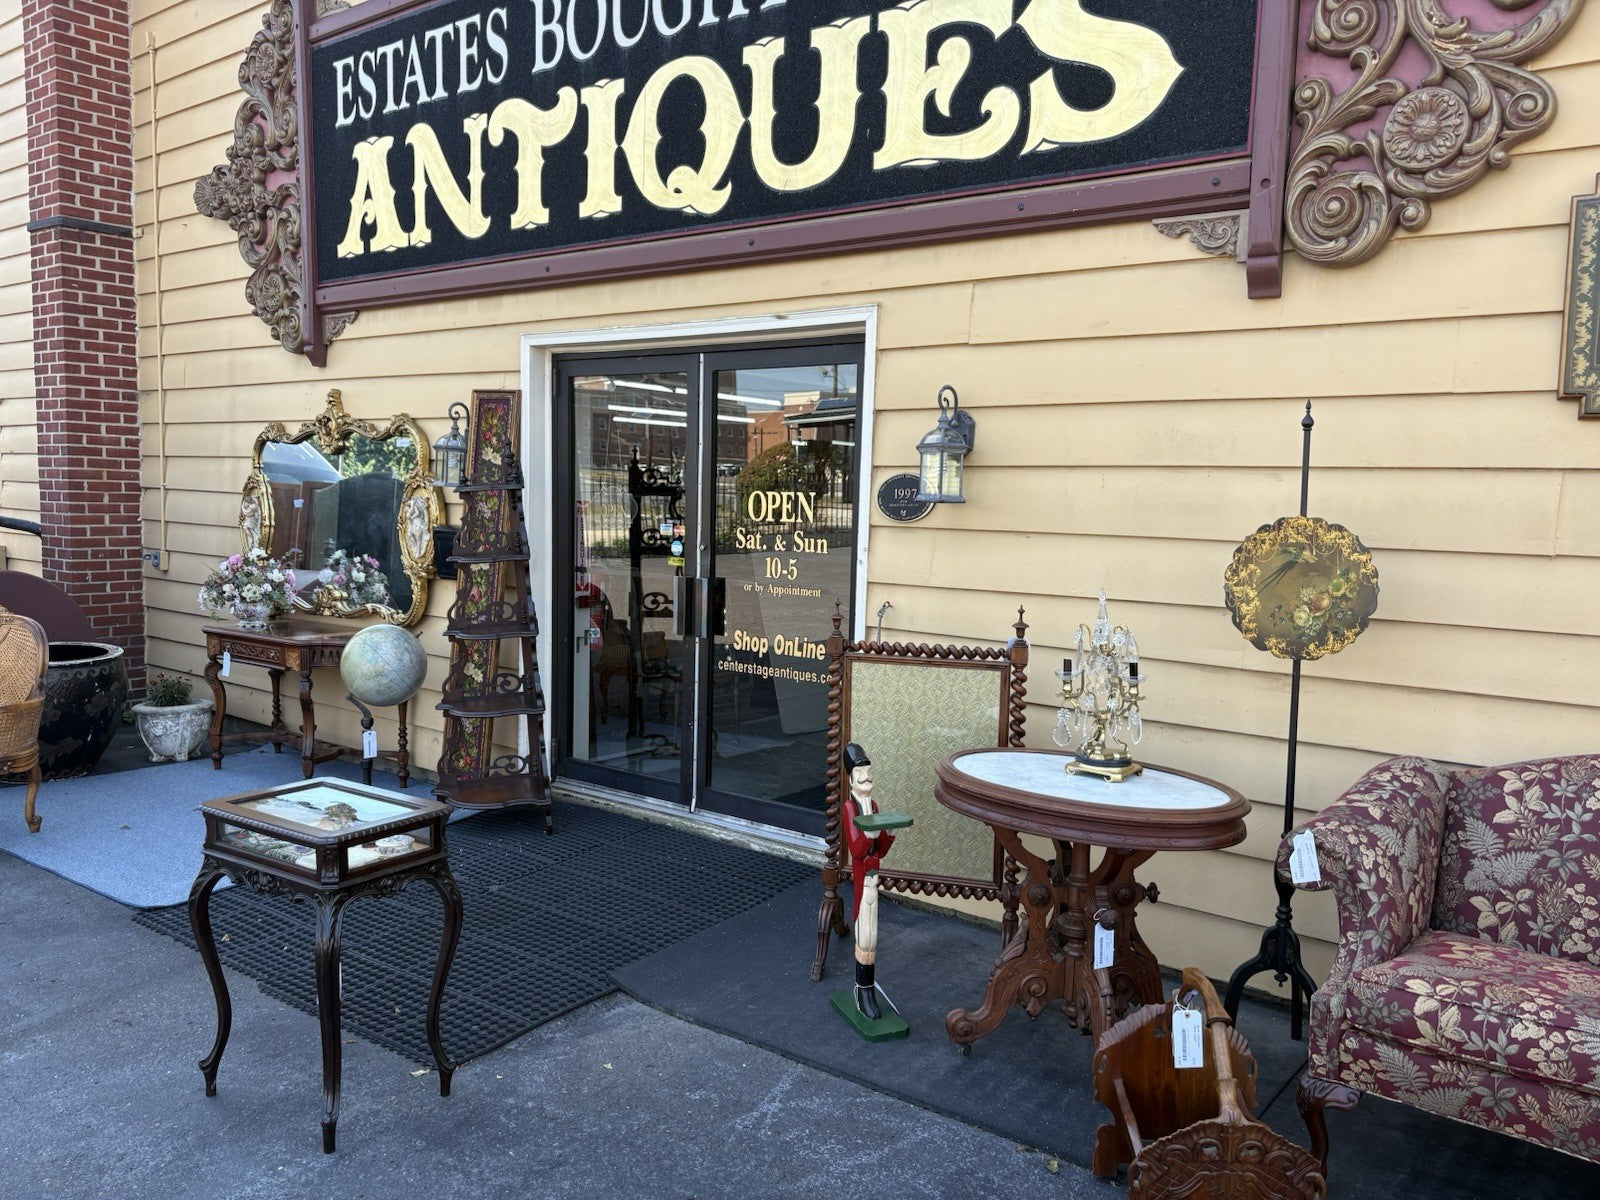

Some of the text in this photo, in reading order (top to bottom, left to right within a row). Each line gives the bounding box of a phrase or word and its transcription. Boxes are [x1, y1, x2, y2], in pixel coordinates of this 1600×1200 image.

[333, 6, 509, 127] ESTATES
[336, 0, 1185, 258] ANTIQUES
[747, 490, 817, 524] OPEN
[893, 488, 918, 499] 1997
[735, 527, 828, 554] Sat. & Sun
[765, 556, 798, 580] 10-5
[743, 582, 822, 598] or by Appointment
[733, 629, 826, 661] Shop OnLine
[717, 660, 843, 686] centerstageantiques.co
